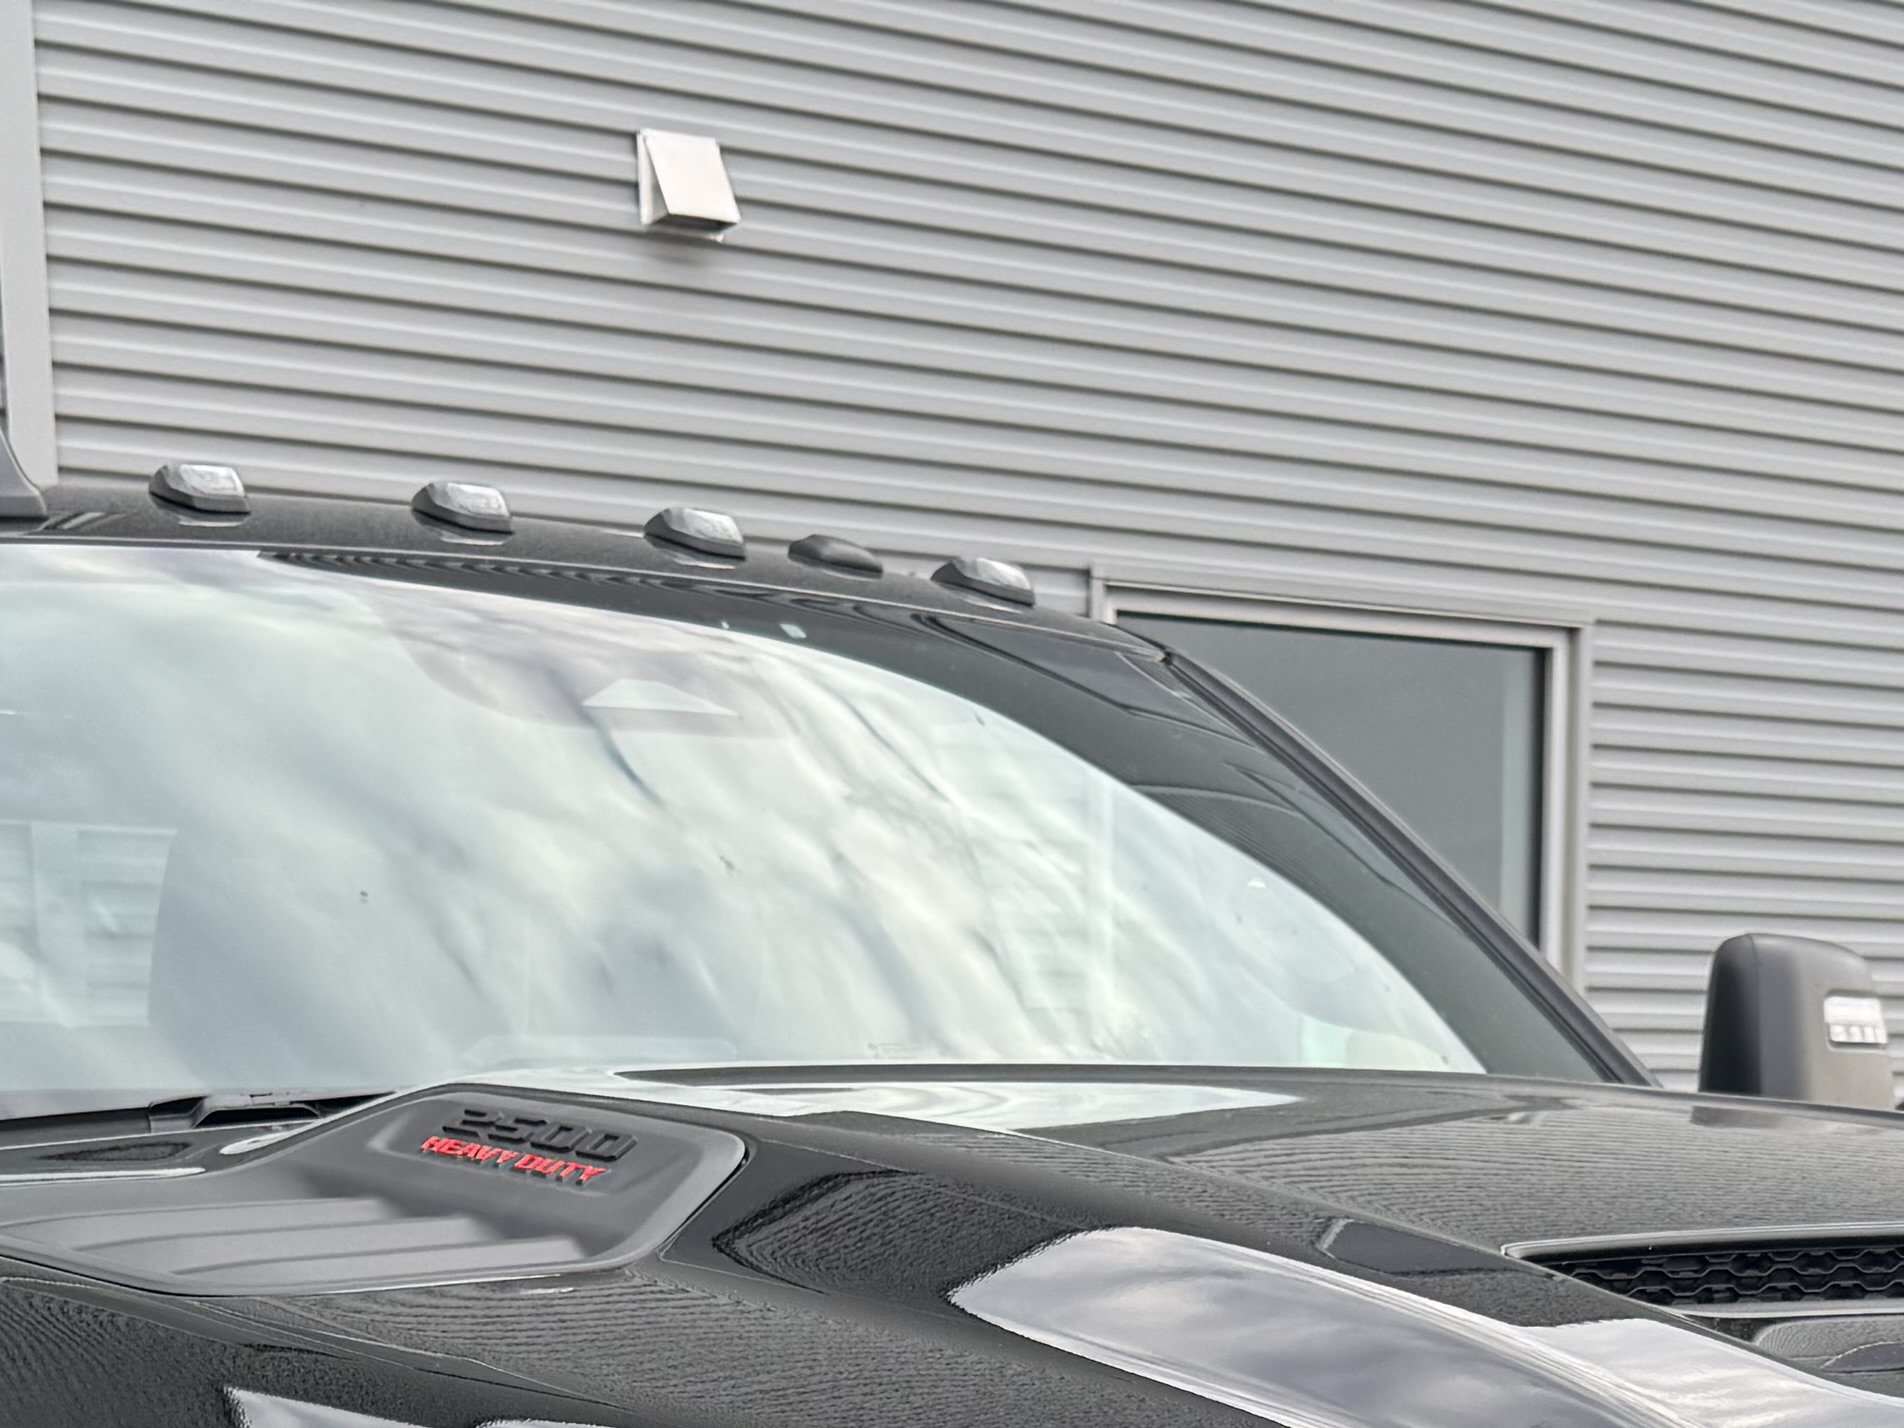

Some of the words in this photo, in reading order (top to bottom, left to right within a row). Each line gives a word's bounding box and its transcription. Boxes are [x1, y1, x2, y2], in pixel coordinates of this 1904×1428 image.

[420, 1136, 519, 1166] HEAVY
[513, 1153, 610, 1185] DUTY
[442, 1108, 639, 1163] 2500
